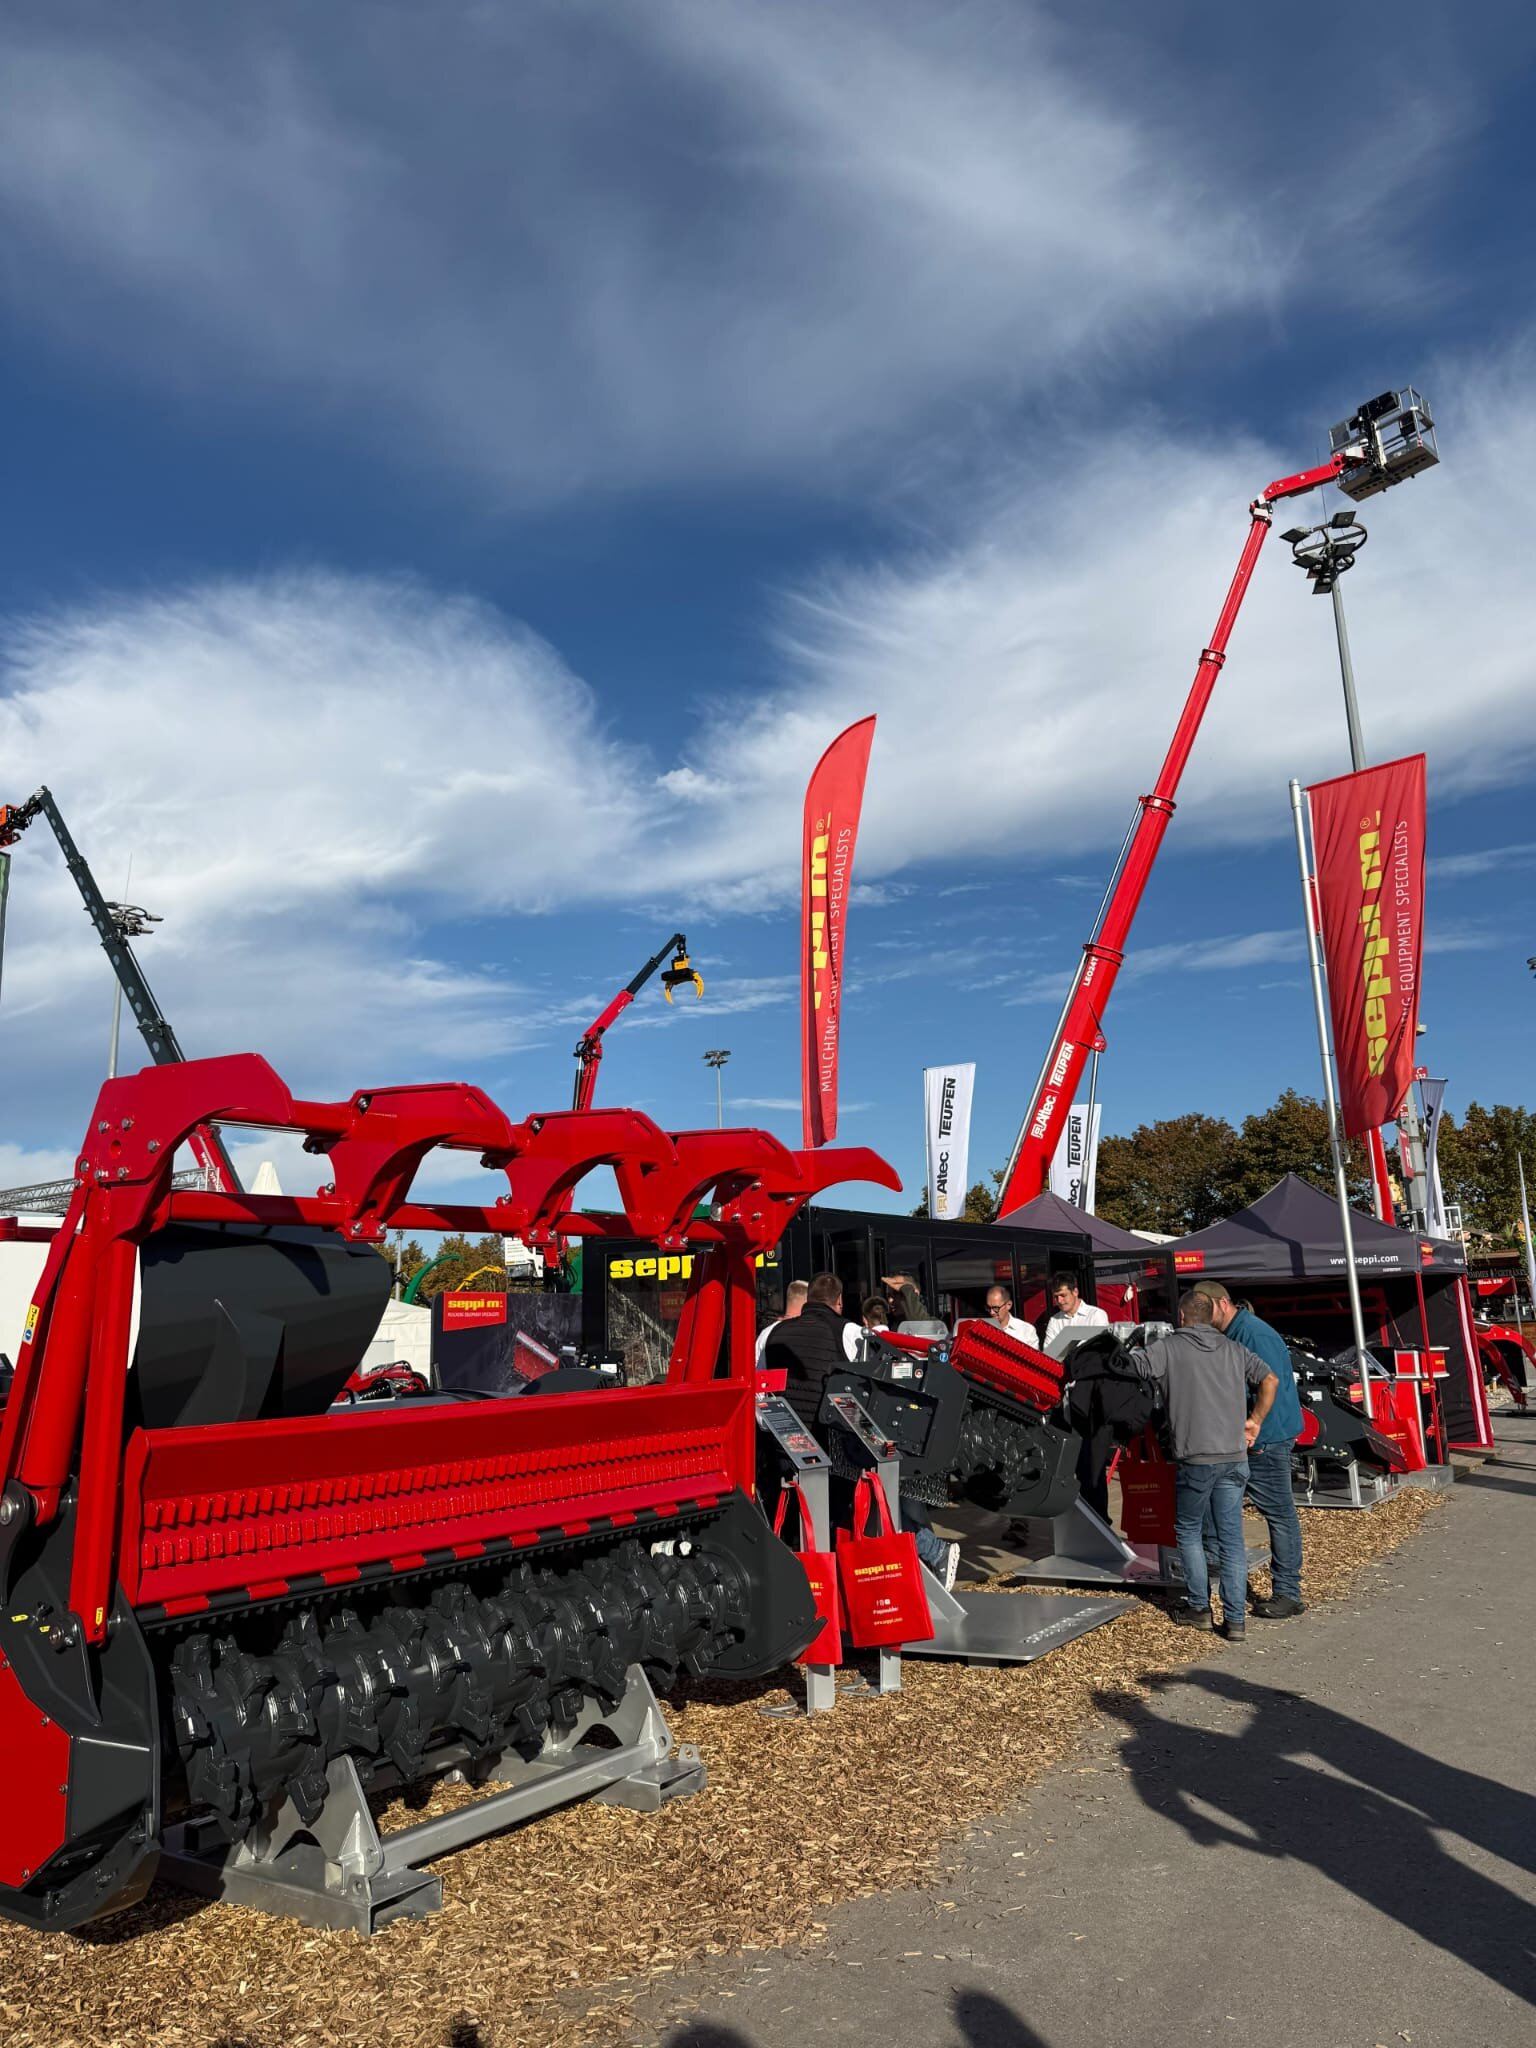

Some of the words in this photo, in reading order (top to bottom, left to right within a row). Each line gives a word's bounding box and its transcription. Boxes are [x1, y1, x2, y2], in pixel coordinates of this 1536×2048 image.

[1394, 821, 1410, 905] SPECIALISTS
[822, 1016, 837, 1092] MULCHING
[830, 829, 851, 918] SPECIALISTS
[1359, 903, 1391, 1077] seppi
[1396, 911, 1414, 991] EQUIPMENT
[939, 1077, 957, 1139] TEUPEN
[1036, 1095, 1057, 1131] Altec
[1049, 1039, 1075, 1087] TEUPEN
[937, 1151, 949, 1194] Altec
[1067, 1115, 1082, 1168] TEUPEN
[448, 1299, 485, 1311] seppi
